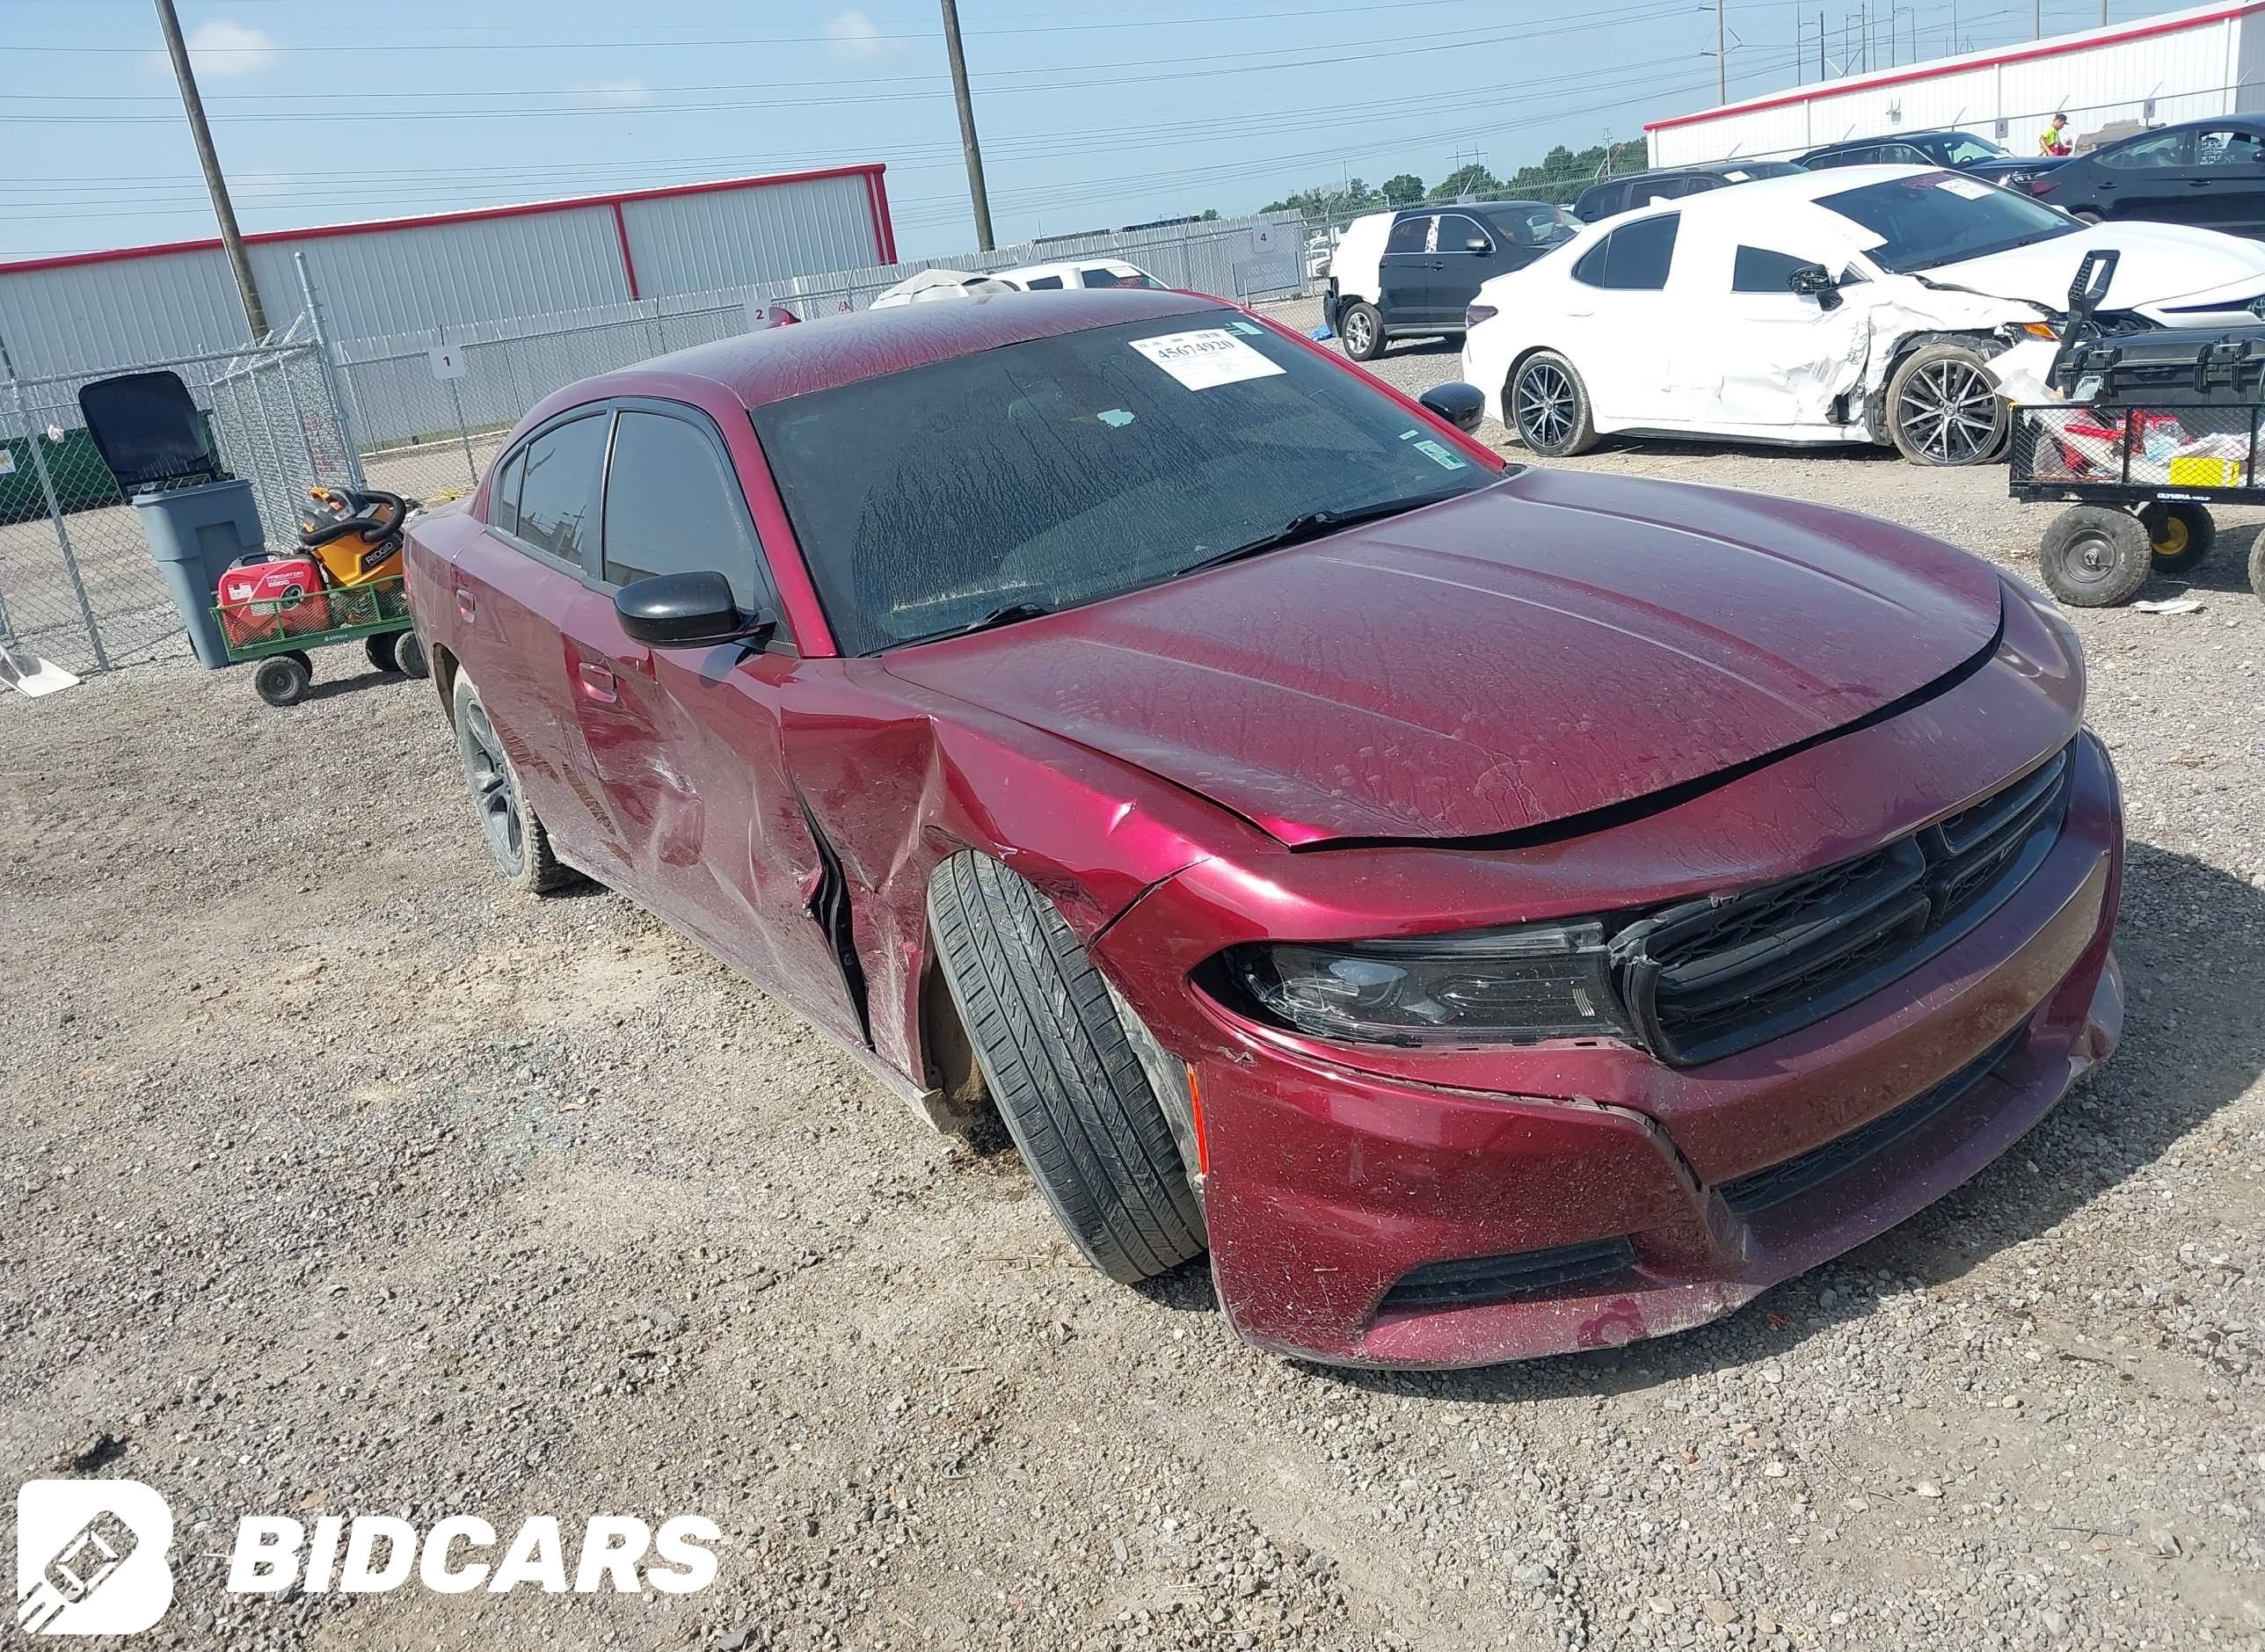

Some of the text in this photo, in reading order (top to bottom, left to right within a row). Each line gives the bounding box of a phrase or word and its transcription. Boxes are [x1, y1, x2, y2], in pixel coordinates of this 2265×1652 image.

[1260, 233, 1267, 243] 4
[754, 309, 764, 320] 2
[1158, 340, 1235, 359] 45674920
[442, 355, 451, 367] 1
[365, 542, 393, 564] RIDGID
[266, 571, 304, 582] PREDATOR
[267, 579, 290, 588] 2000
